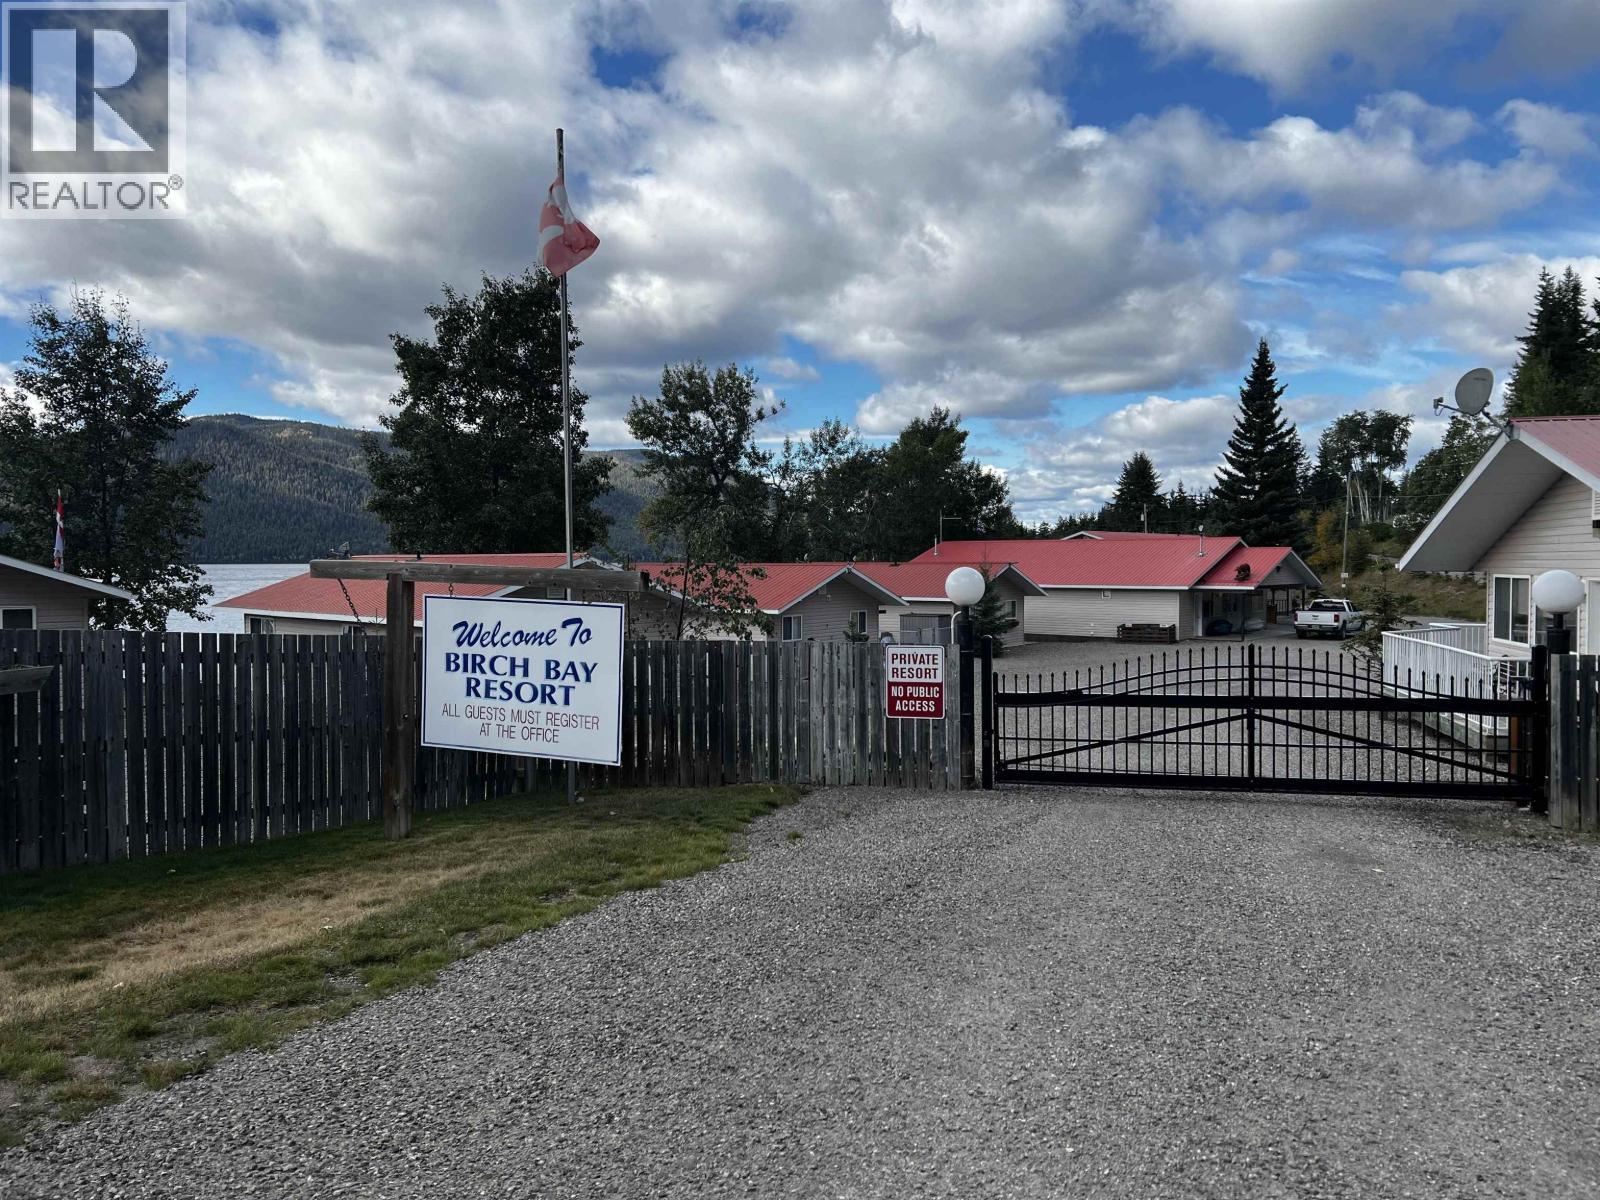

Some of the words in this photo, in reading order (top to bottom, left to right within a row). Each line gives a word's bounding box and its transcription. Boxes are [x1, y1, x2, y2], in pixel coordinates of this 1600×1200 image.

[452, 620, 557, 648] Welcome
[561, 617, 592, 647] To
[445, 652, 530, 678] BIRCH
[545, 659, 598, 683] BAY
[892, 653, 939, 665] PRIVATE
[892, 667, 939, 679] RESORT
[465, 677, 576, 706] RESORT
[891, 685, 904, 697] NO
[906, 686, 940, 698] PUBLIC
[895, 700, 935, 712] ACCESS
[441, 703, 460, 718] ALL
[464, 704, 506, 722] GUESTS
[510, 709, 541, 725] MUST
[545, 712, 600, 731] REGISTER
[479, 723, 491, 737] AT
[496, 724, 516, 739] THE
[521, 726, 560, 744] OFFICE
